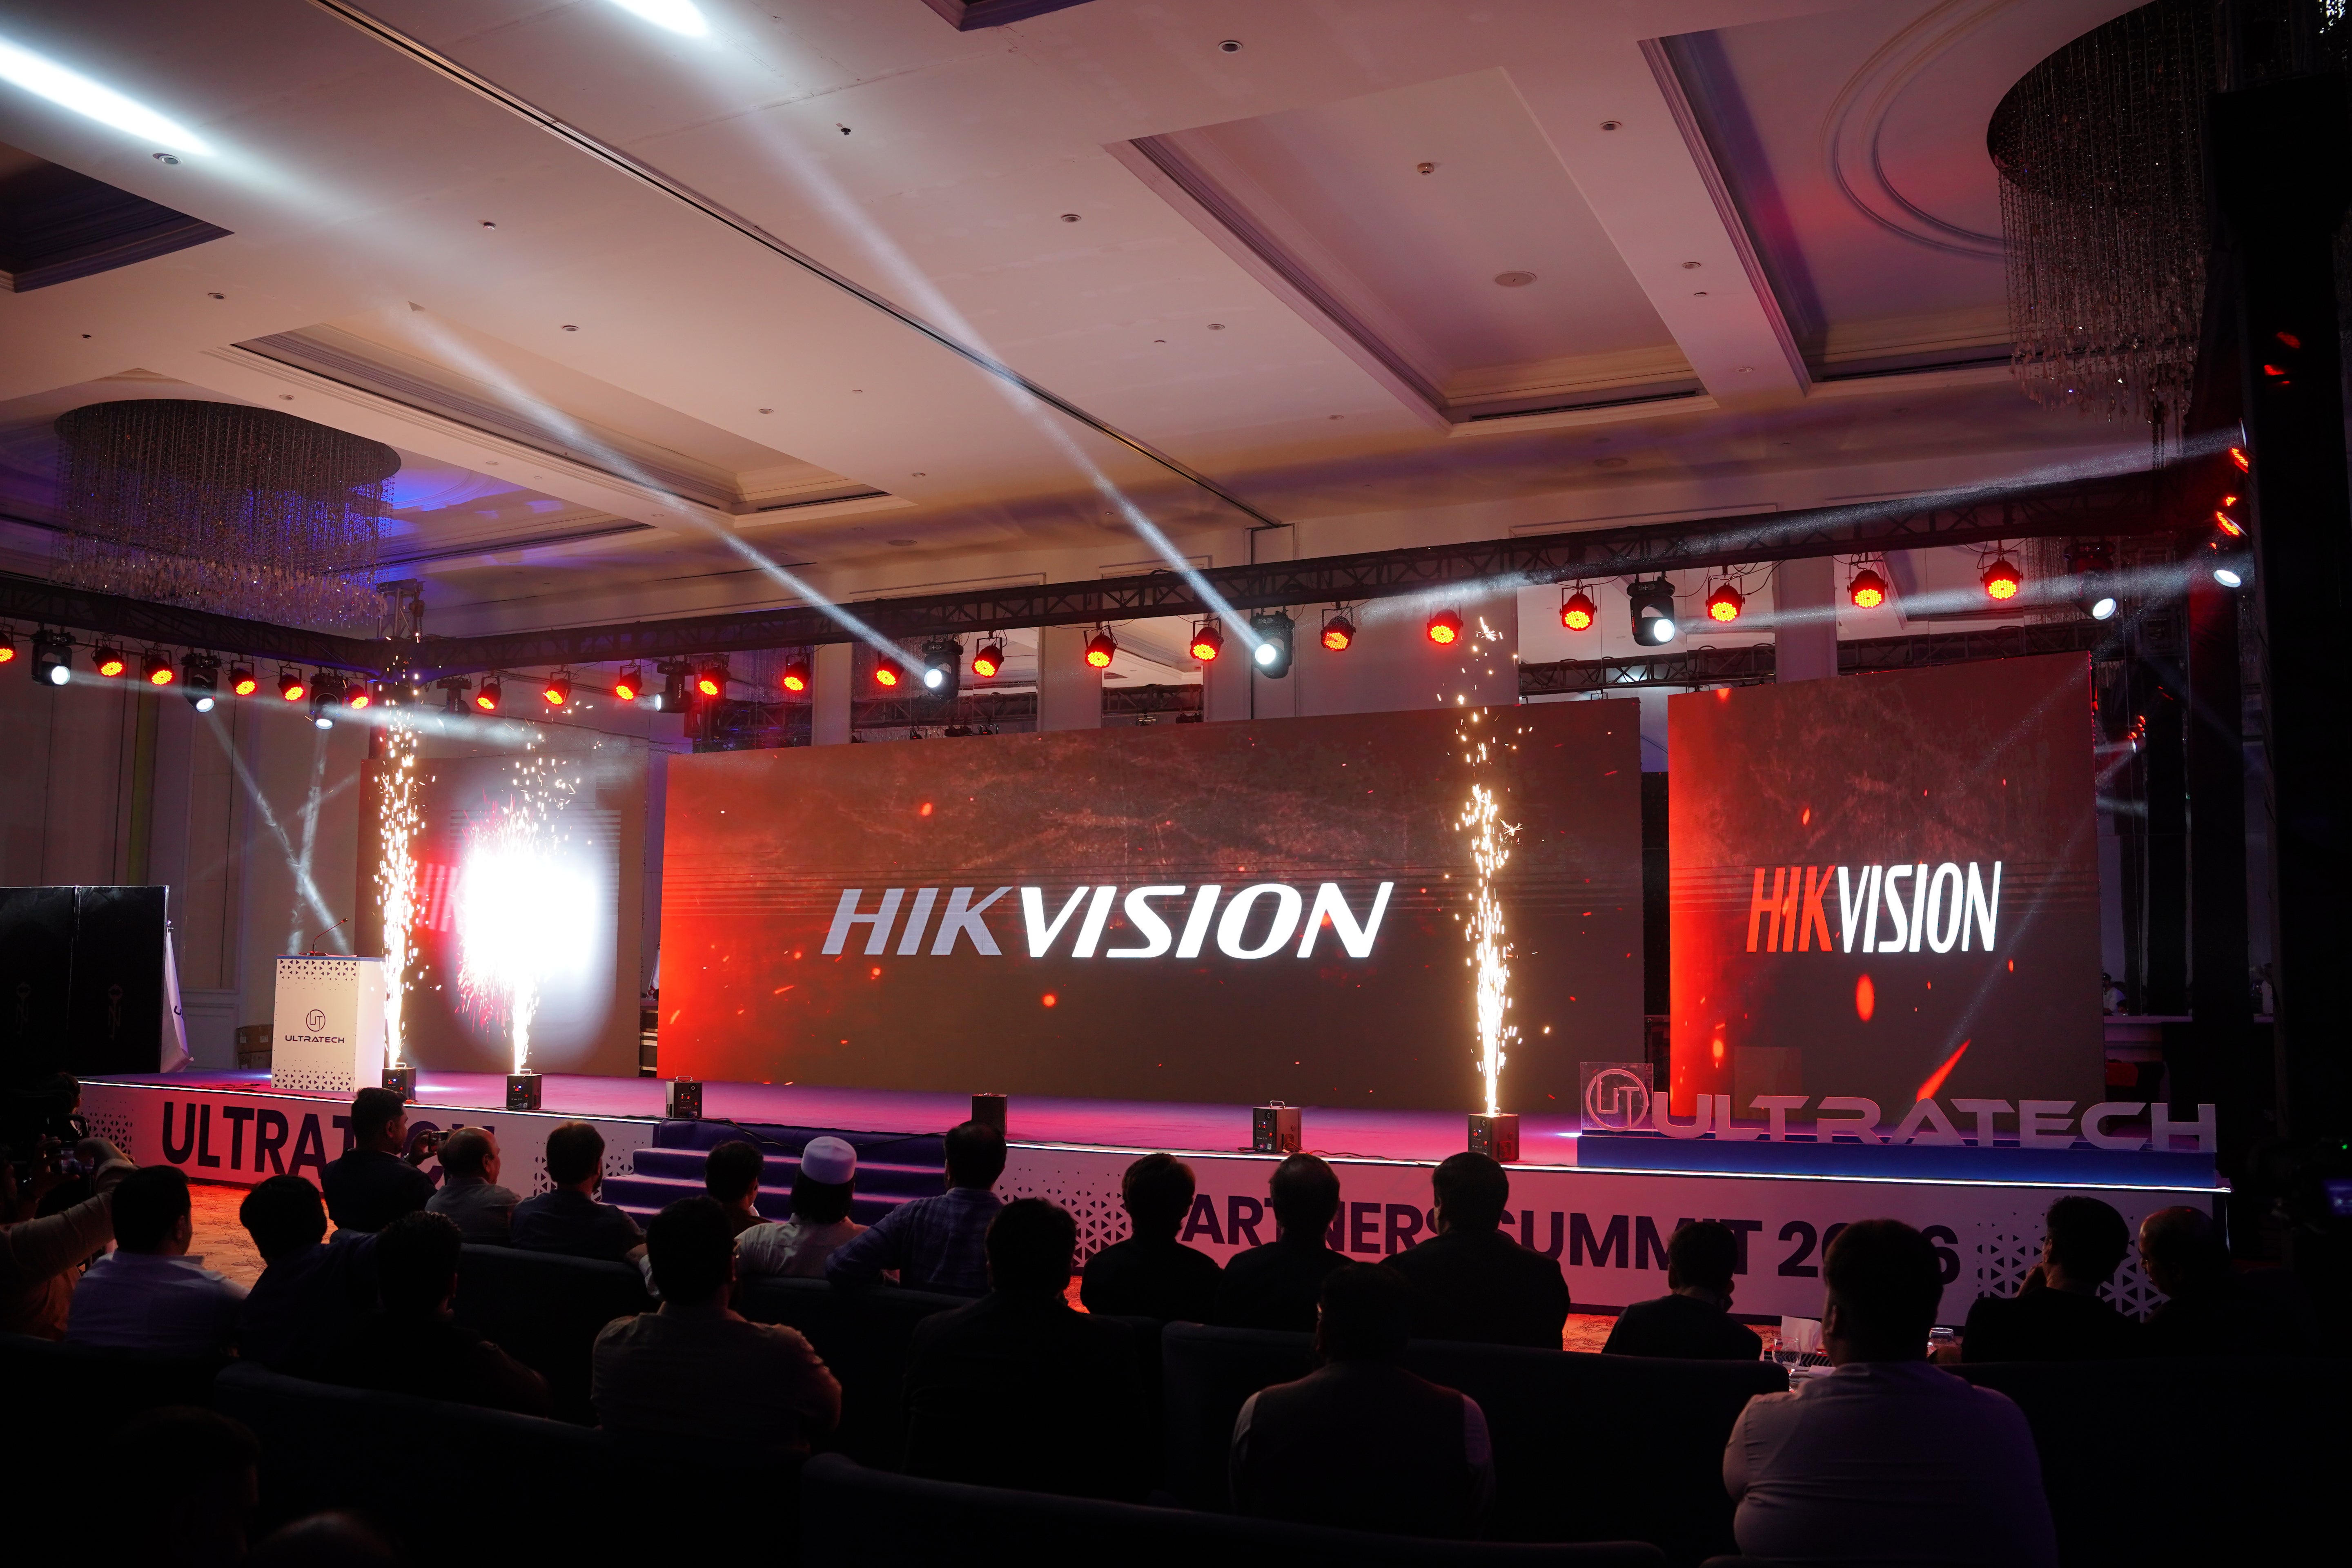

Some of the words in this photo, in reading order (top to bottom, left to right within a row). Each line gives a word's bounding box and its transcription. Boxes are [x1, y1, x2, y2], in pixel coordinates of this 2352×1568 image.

[821, 882, 1394, 959] HIKVISION
[1746, 861, 2001, 953] HIKVISION
[285, 1035, 344, 1043] ULTRATECH
[1653, 1091, 2217, 1153] ULTRATECH
